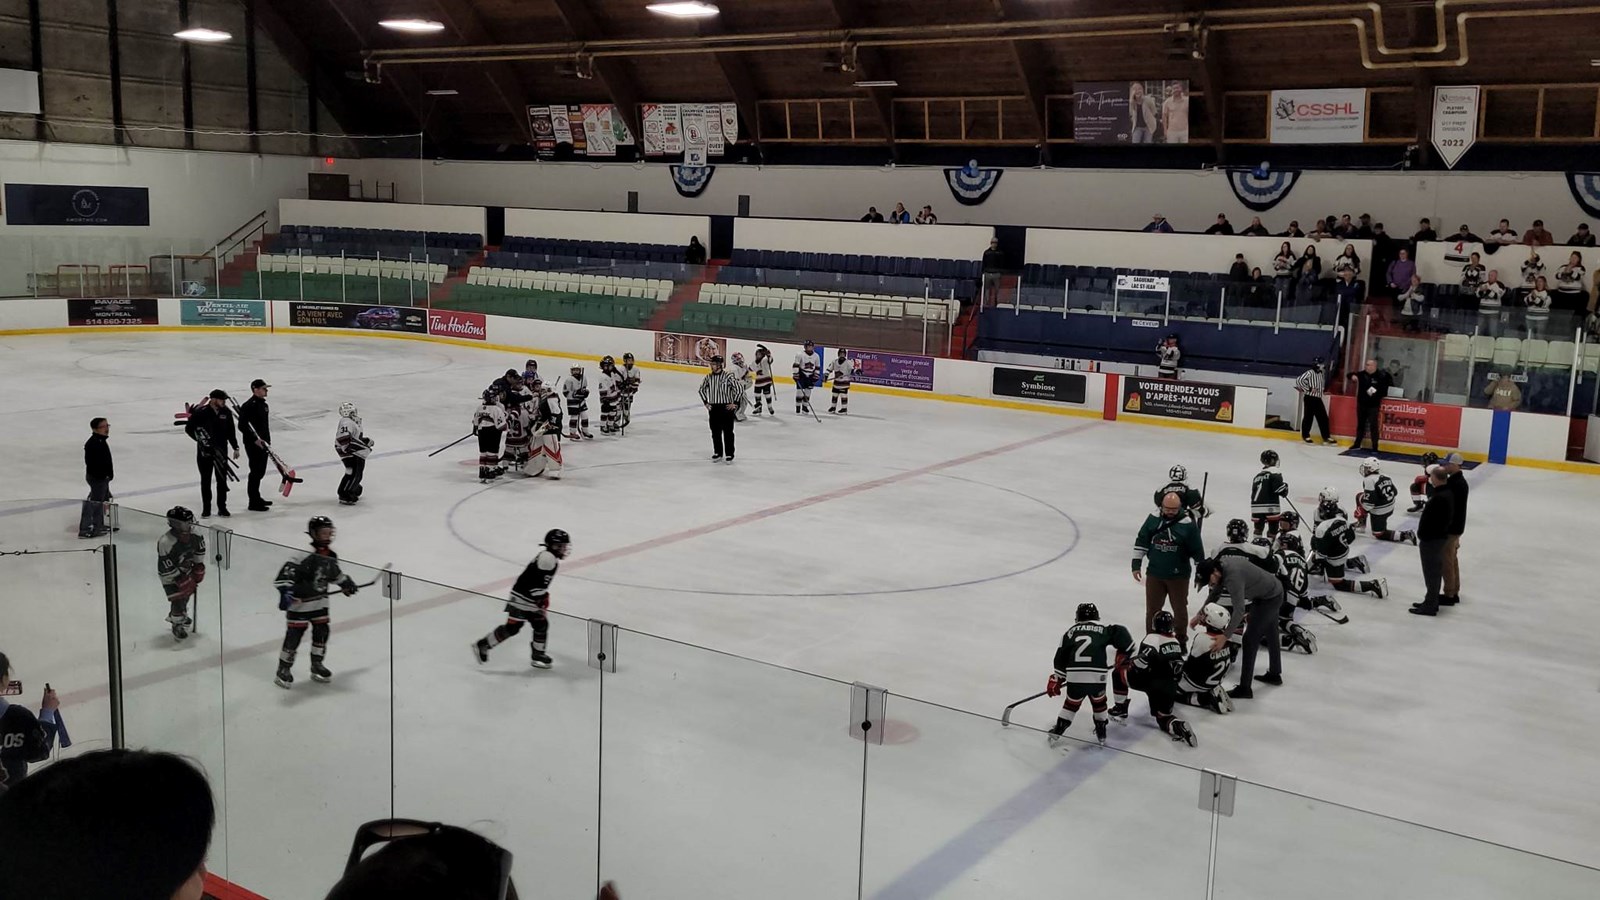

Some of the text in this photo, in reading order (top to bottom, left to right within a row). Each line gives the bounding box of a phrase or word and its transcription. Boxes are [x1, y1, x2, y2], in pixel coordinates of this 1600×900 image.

[1297, 102, 1359, 116] CSSHL
[1442, 139, 1464, 147] 2022
[1454, 241, 1464, 255] 4
[307, 310, 326, 318] VIENT
[429, 315, 485, 335] Tim Hortons
[1021, 381, 1056, 391] Symbiose
[1139, 382, 1220, 397] VOTRE RENDEZ-VOUS
[1145, 391, 1211, 406] D'APRÈS-MATCH!
[1380, 403, 1427, 415] ncaillerie
[1384, 413, 1425, 428] Home
[1382, 424, 1425, 436] hardware
[162, 558, 173, 569] 10
[1074, 635, 1093, 663] 2
[0, 732, 25, 752] OS
